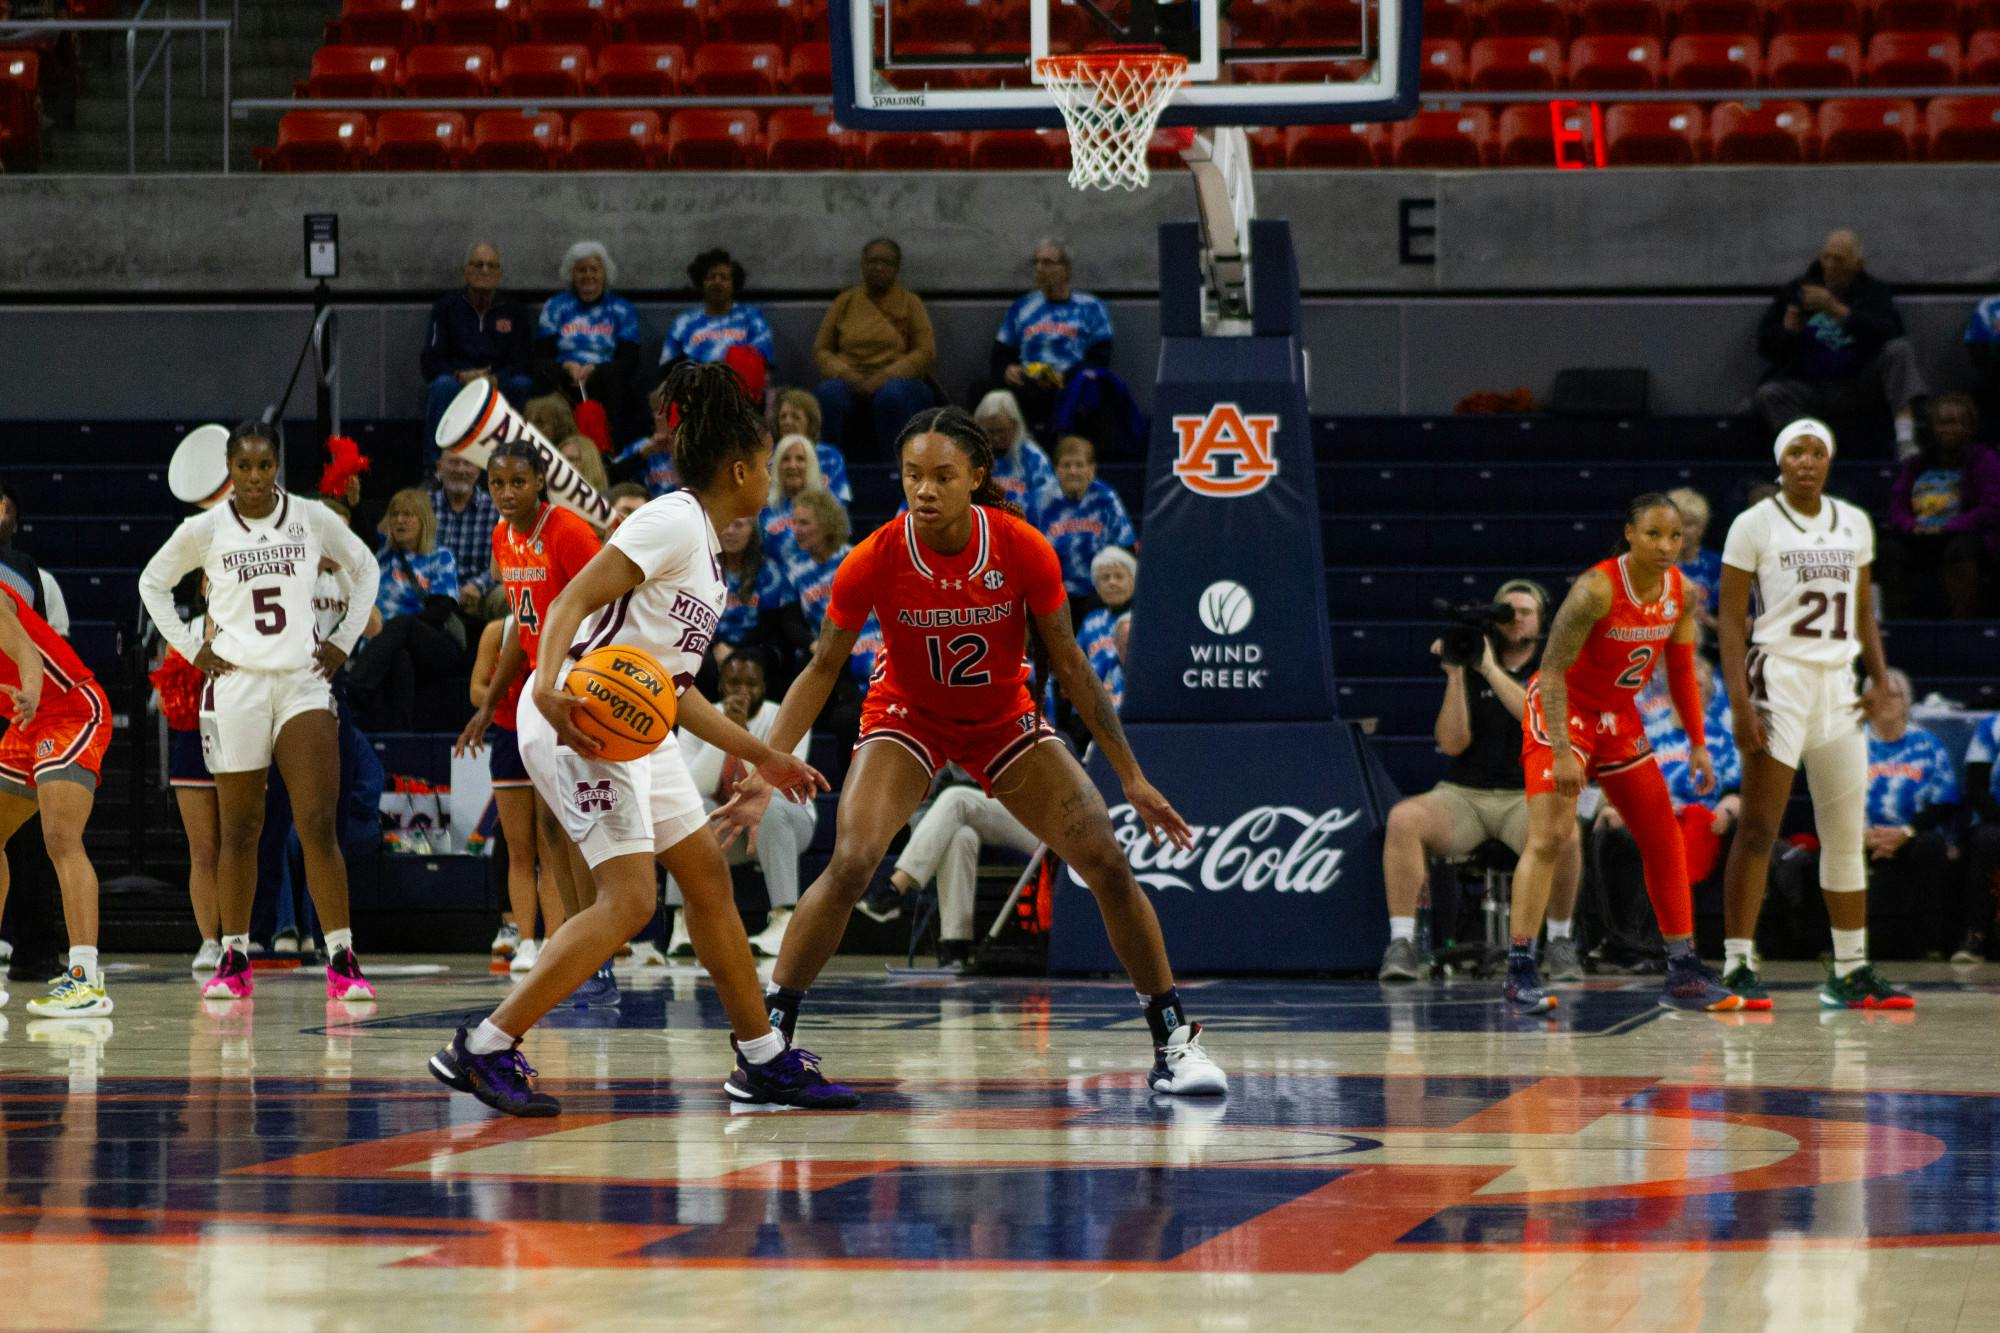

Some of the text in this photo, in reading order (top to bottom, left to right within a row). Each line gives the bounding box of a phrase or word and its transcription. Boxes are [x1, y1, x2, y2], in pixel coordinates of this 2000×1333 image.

[872, 96, 926, 108] SPALDING
[1399, 198, 1435, 265] E
[222, 546, 306, 569] MISSISSIPPI
[246, 562, 287, 579] STATE
[502, 567, 547, 581] UBURN
[983, 569, 1005, 590] SEC
[1805, 566, 1842, 580] STATE
[252, 587, 287, 636] 5
[509, 587, 538, 635] 14
[897, 600, 1013, 628] AUBURN
[1790, 590, 1848, 640] 21
[926, 633, 992, 688] 12
[1190, 645, 1262, 663] WIND
[611, 657, 664, 698] NCAA
[1182, 669, 1263, 689] CREEK
[1615, 645, 1653, 689] 2
[586, 677, 655, 737] Wilson
[579, 790, 610, 802] STATE
